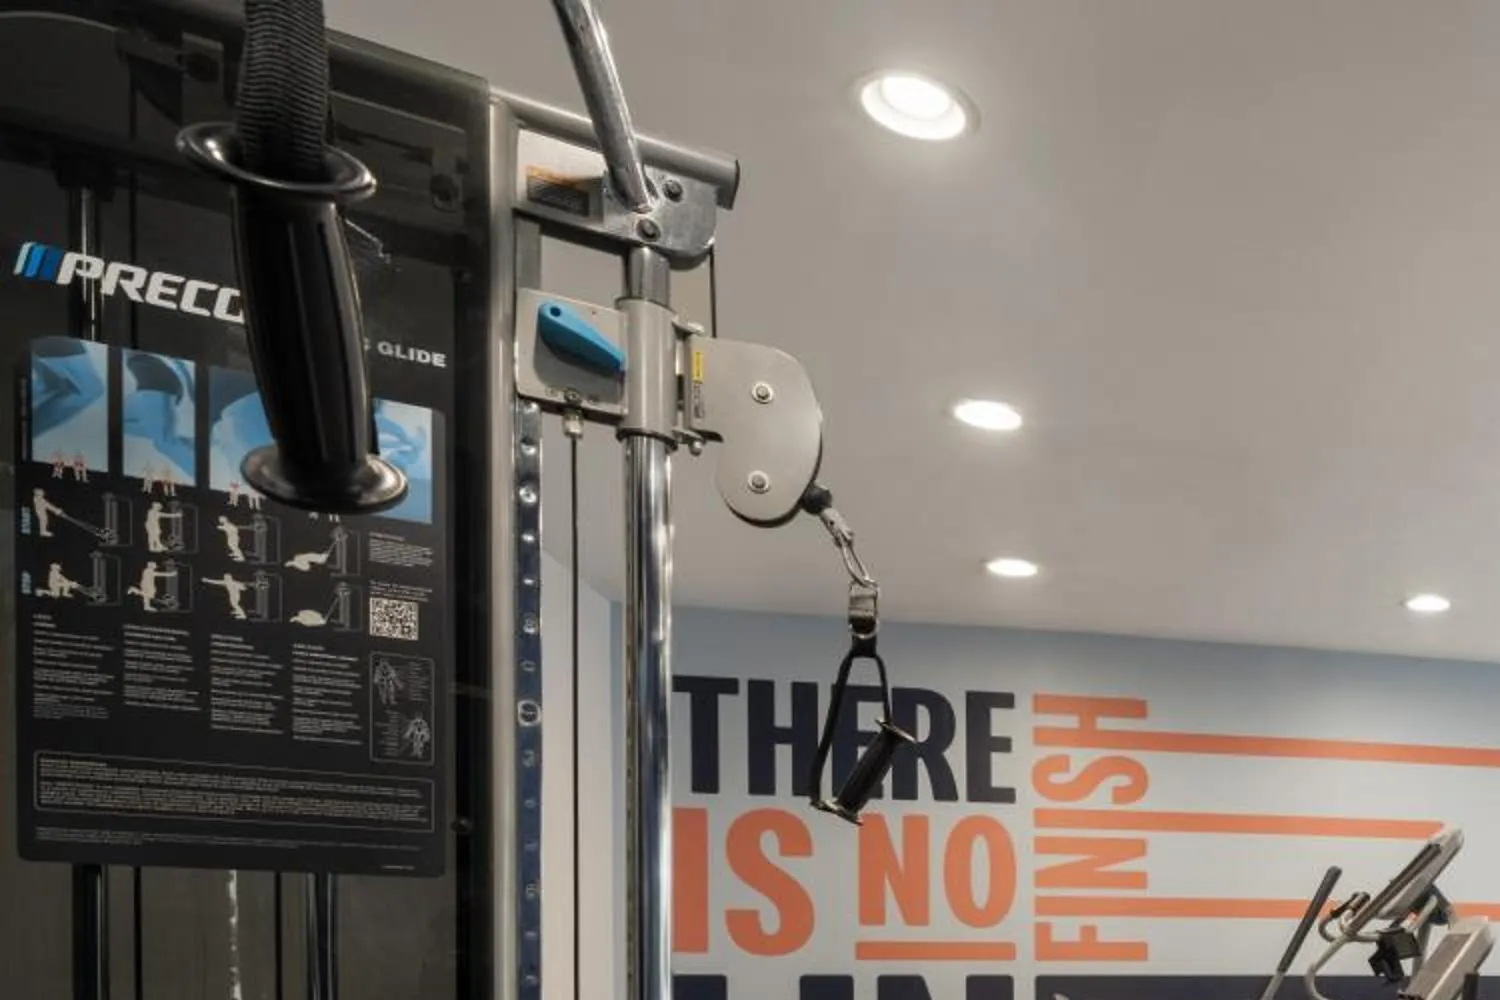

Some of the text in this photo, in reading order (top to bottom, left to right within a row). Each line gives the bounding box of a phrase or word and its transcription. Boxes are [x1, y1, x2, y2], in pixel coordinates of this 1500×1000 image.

[56, 251, 246, 324] PRECO
[377, 341, 447, 367] GLIDE
[672, 675, 1016, 804] THERE
[672, 807, 1017, 957] IS NO
[1032, 692, 1149, 961] FINISH
